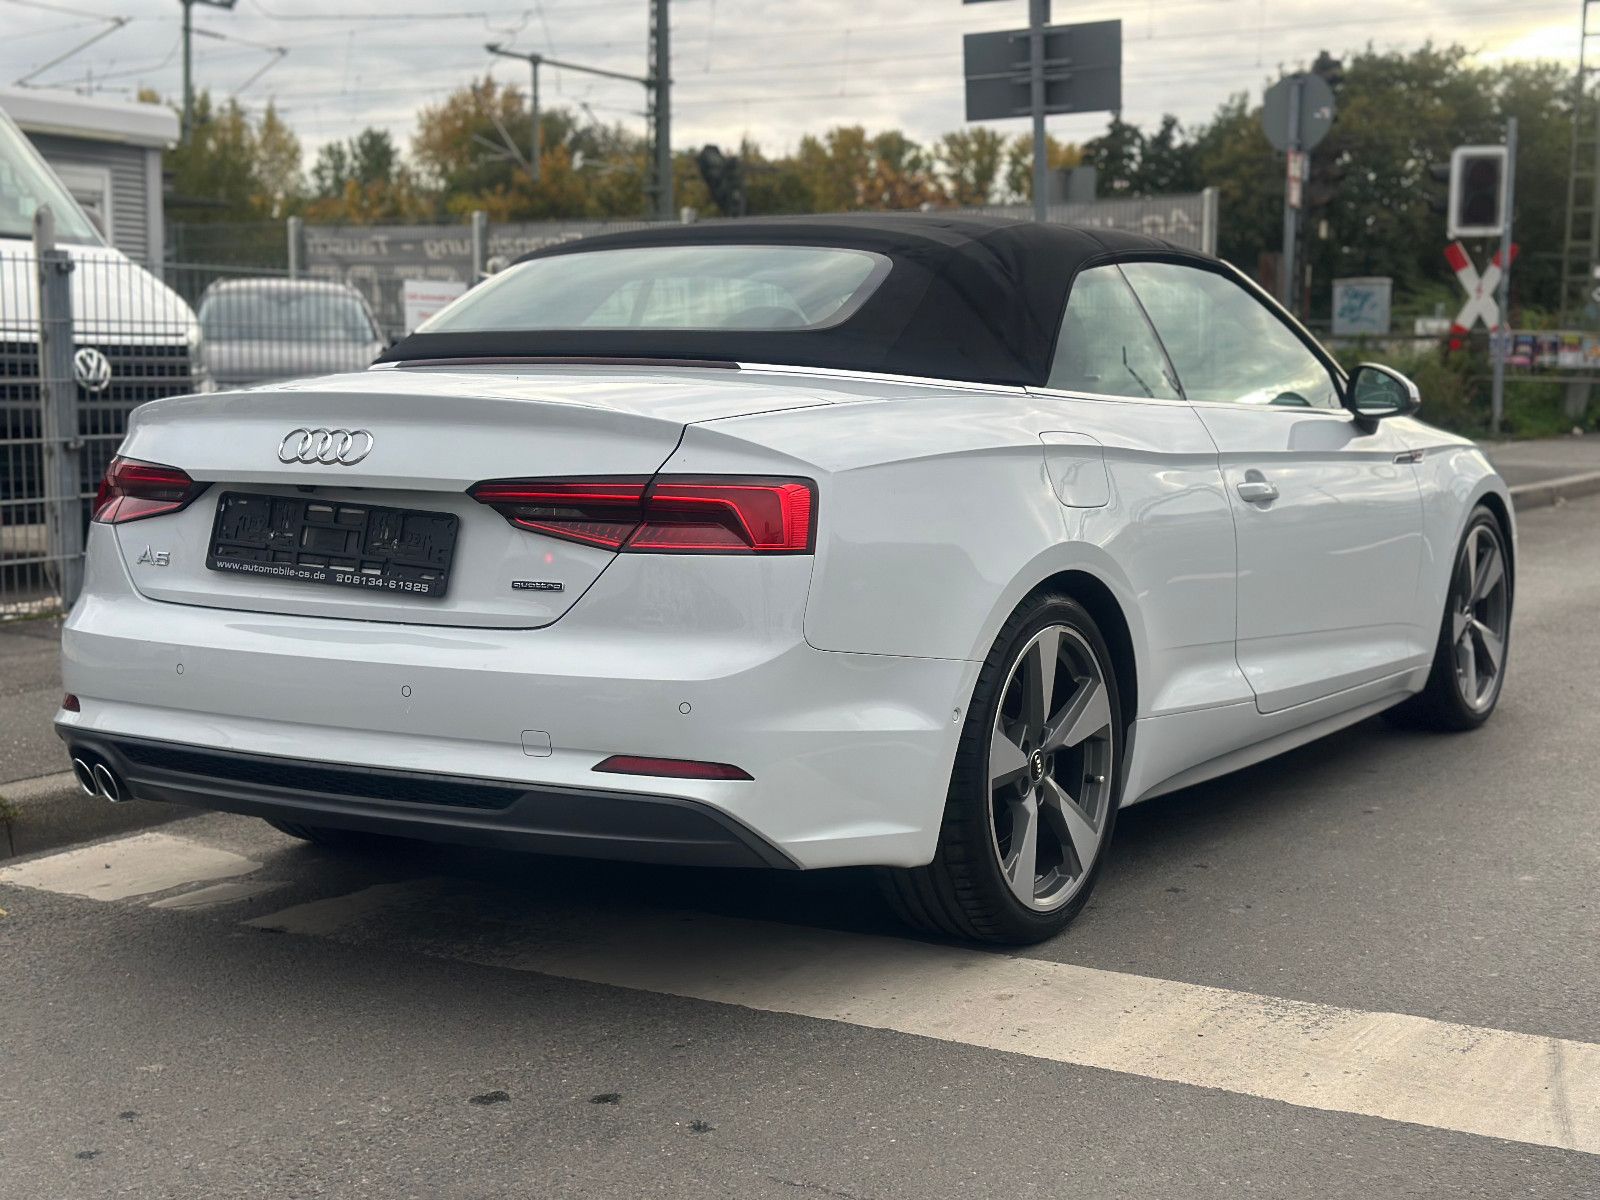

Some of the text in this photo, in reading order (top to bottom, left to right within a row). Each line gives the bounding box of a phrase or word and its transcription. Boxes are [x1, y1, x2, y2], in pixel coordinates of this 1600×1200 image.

[136, 544, 170, 567] A5
[216, 559, 326, 580] www.automobile-cs.de
[512, 581, 562, 590] quattro
